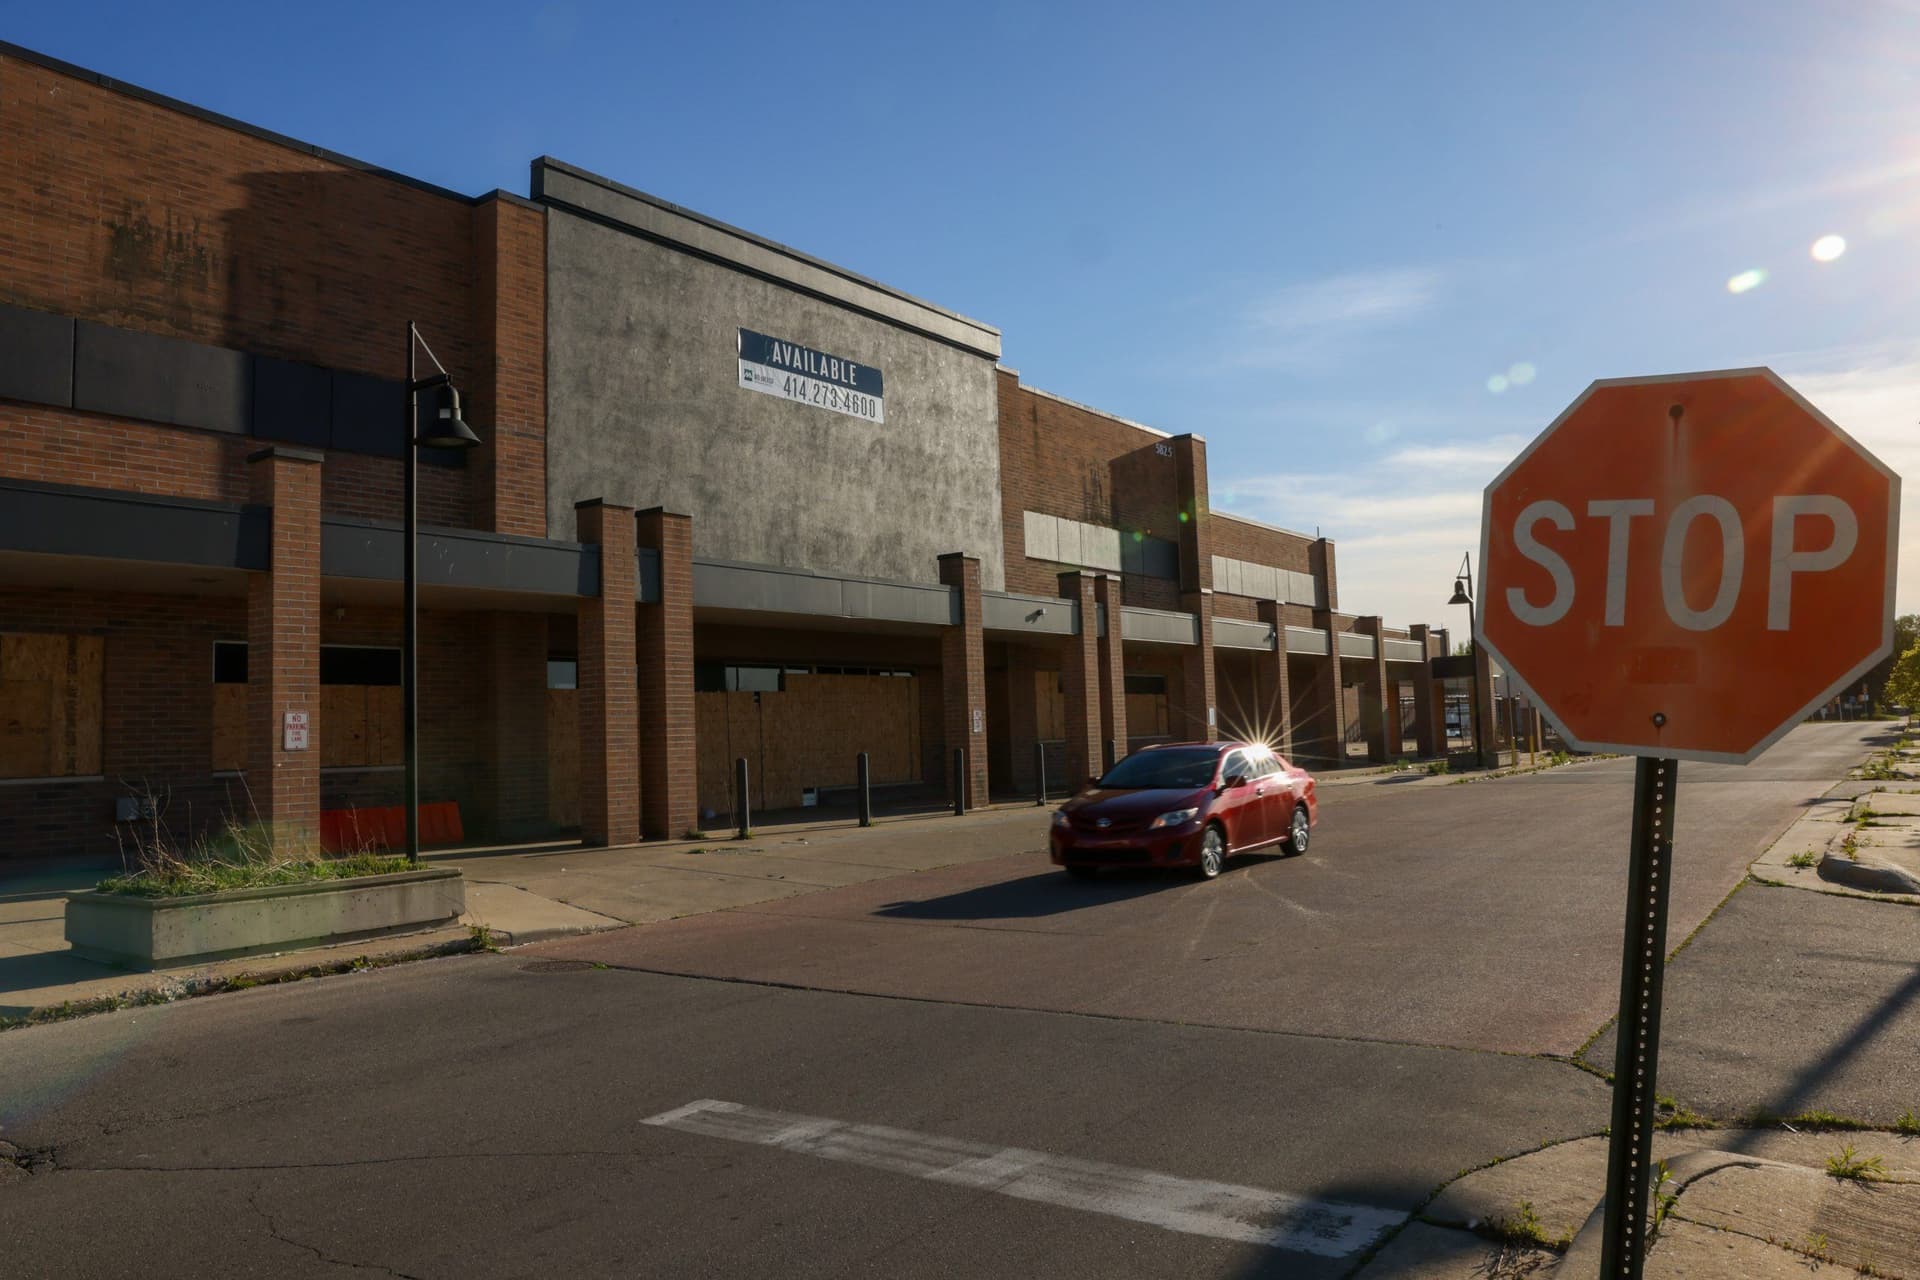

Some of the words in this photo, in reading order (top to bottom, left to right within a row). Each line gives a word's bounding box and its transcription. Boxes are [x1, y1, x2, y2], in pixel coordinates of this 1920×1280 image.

[772, 341, 857, 385] AVAILABLE
[784, 375, 876, 418] 414.273.4600
[1506, 494, 1858, 631] STOP
